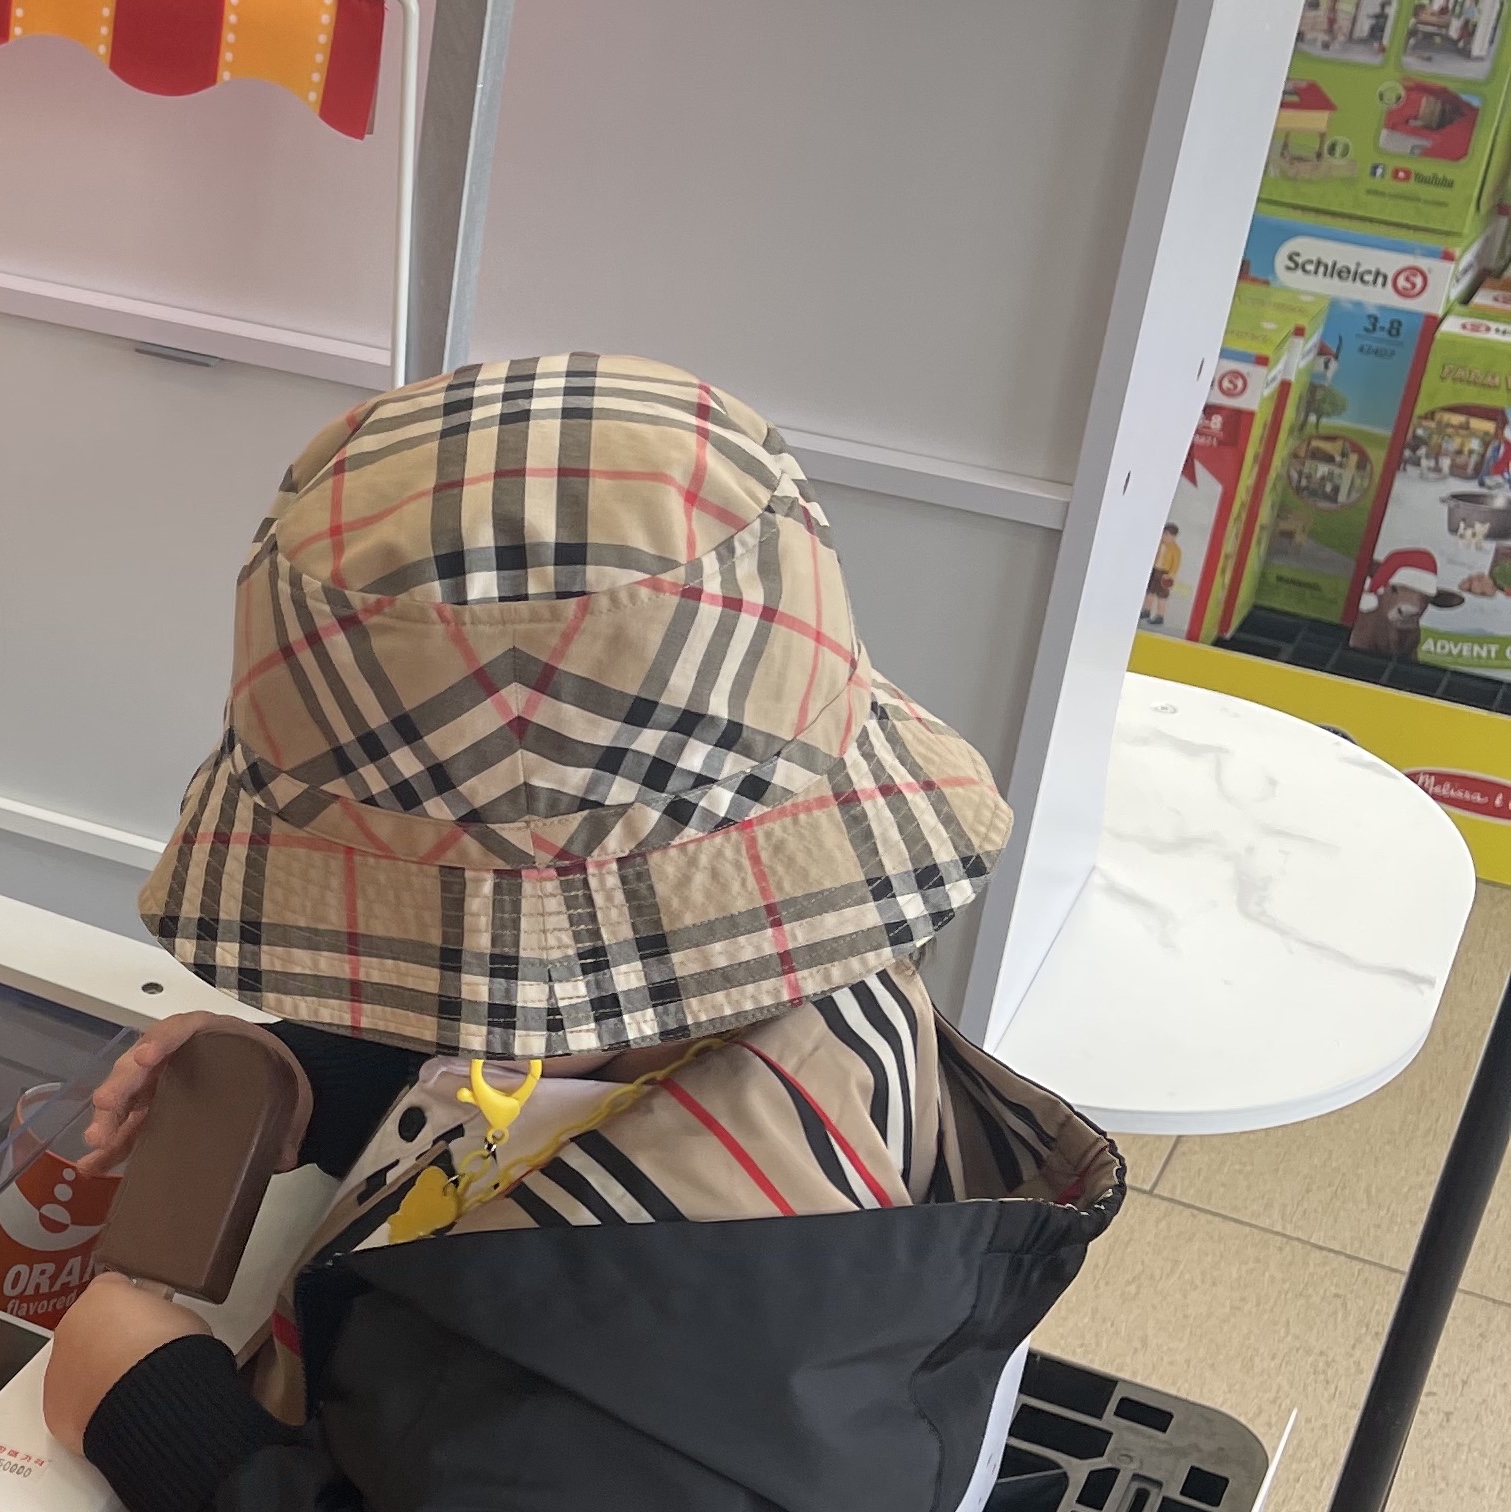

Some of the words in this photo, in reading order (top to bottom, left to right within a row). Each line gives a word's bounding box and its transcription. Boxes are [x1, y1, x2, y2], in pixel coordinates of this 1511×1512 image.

[1285, 250, 1388, 288] Schleich
[1363, 314, 1402, 337] 3-8
[1421, 637, 1499, 658] ADVENT
[1415, 772, 1489, 805] Melissa
[7, 1289, 79, 1316] flavored
